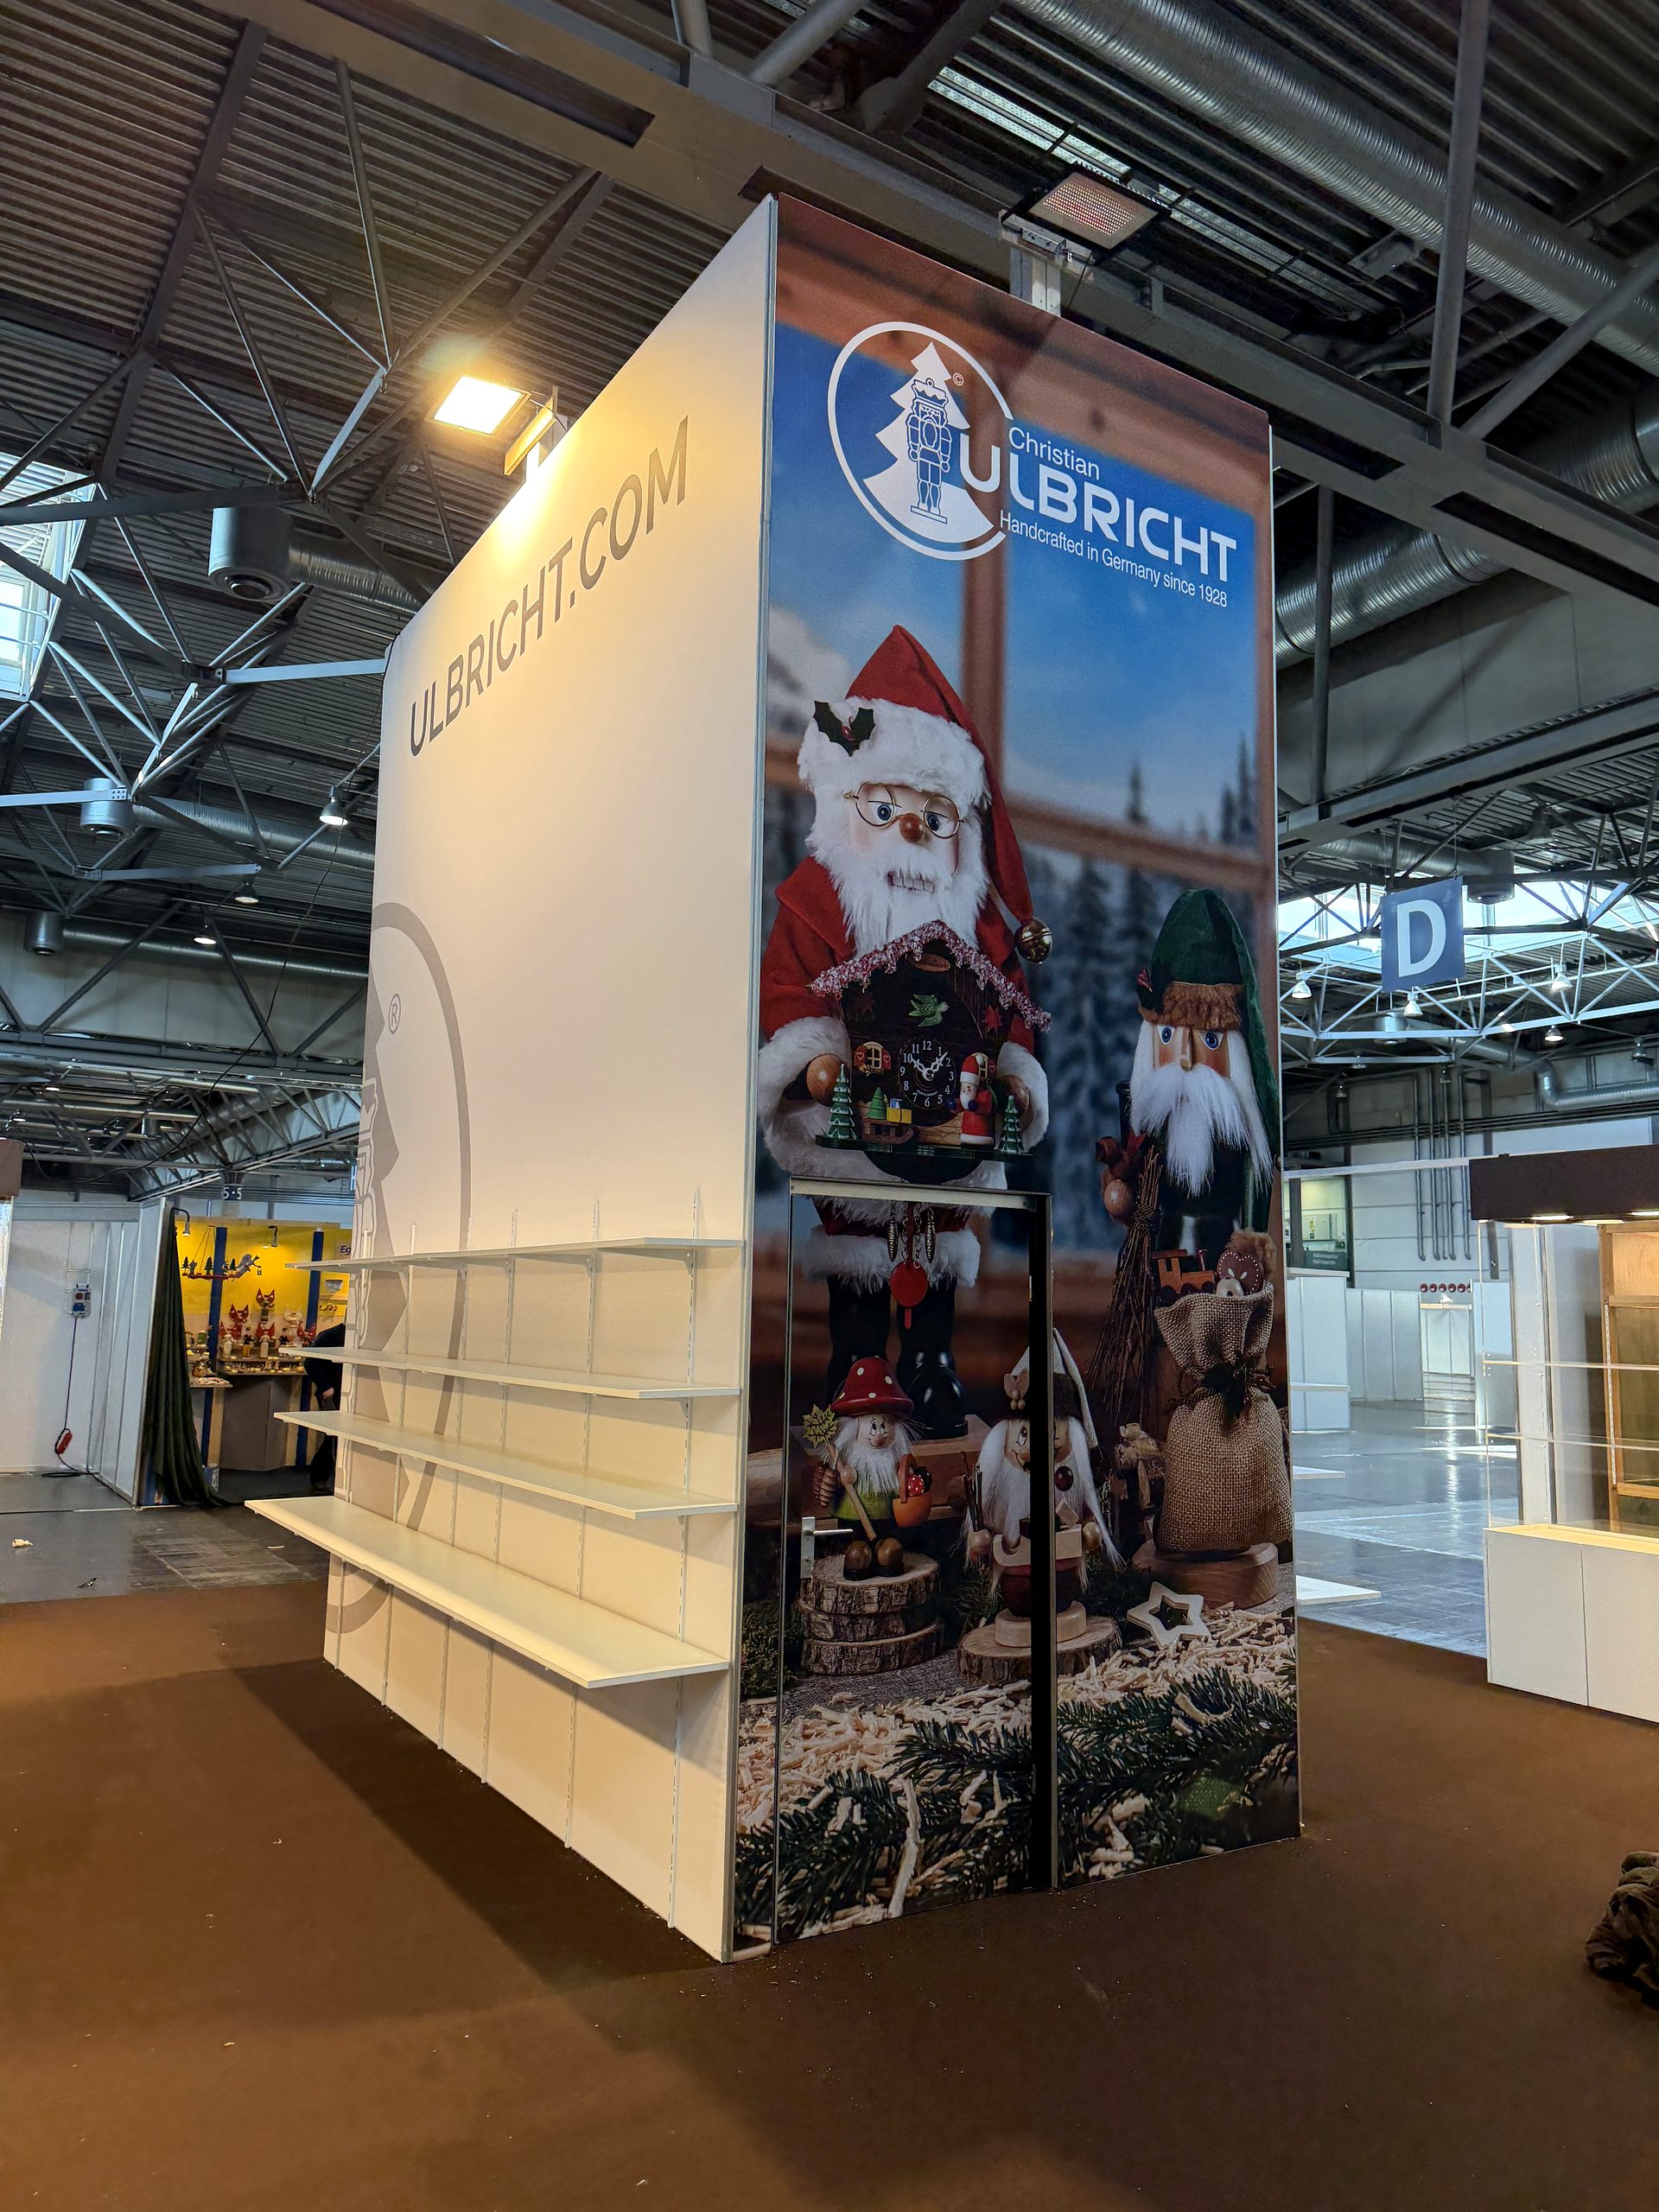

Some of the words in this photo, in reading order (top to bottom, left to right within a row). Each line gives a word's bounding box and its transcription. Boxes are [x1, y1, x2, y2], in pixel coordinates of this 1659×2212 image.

[1008, 427, 1100, 480] Christian
[959, 434, 1236, 582] ULBRICHT
[1000, 510, 1084, 557] Handcrafted
[1087, 542, 1099, 563] in
[1102, 549, 1160, 587] Germany
[1163, 572, 1196, 596] since
[1199, 583, 1228, 607] 1928
[410, 416, 689, 757] ULBRICHT.COM
[1396, 899, 1447, 978] D
[912, 1044, 920, 1054] 11
[922, 1040, 932, 1051] 12
[938, 1046, 942, 1056] 1
[903, 1053, 912, 1063] 10
[945, 1058, 951, 1067] 2
[899, 1066, 906, 1077] 9
[949, 1071, 955, 1081] 3
[903, 1080, 909, 1090] 8
[944, 1084, 950, 1095] 4
[912, 1092, 918, 1103] 7
[925, 1097, 931, 1107] 6
[938, 1094, 943, 1104] 5
